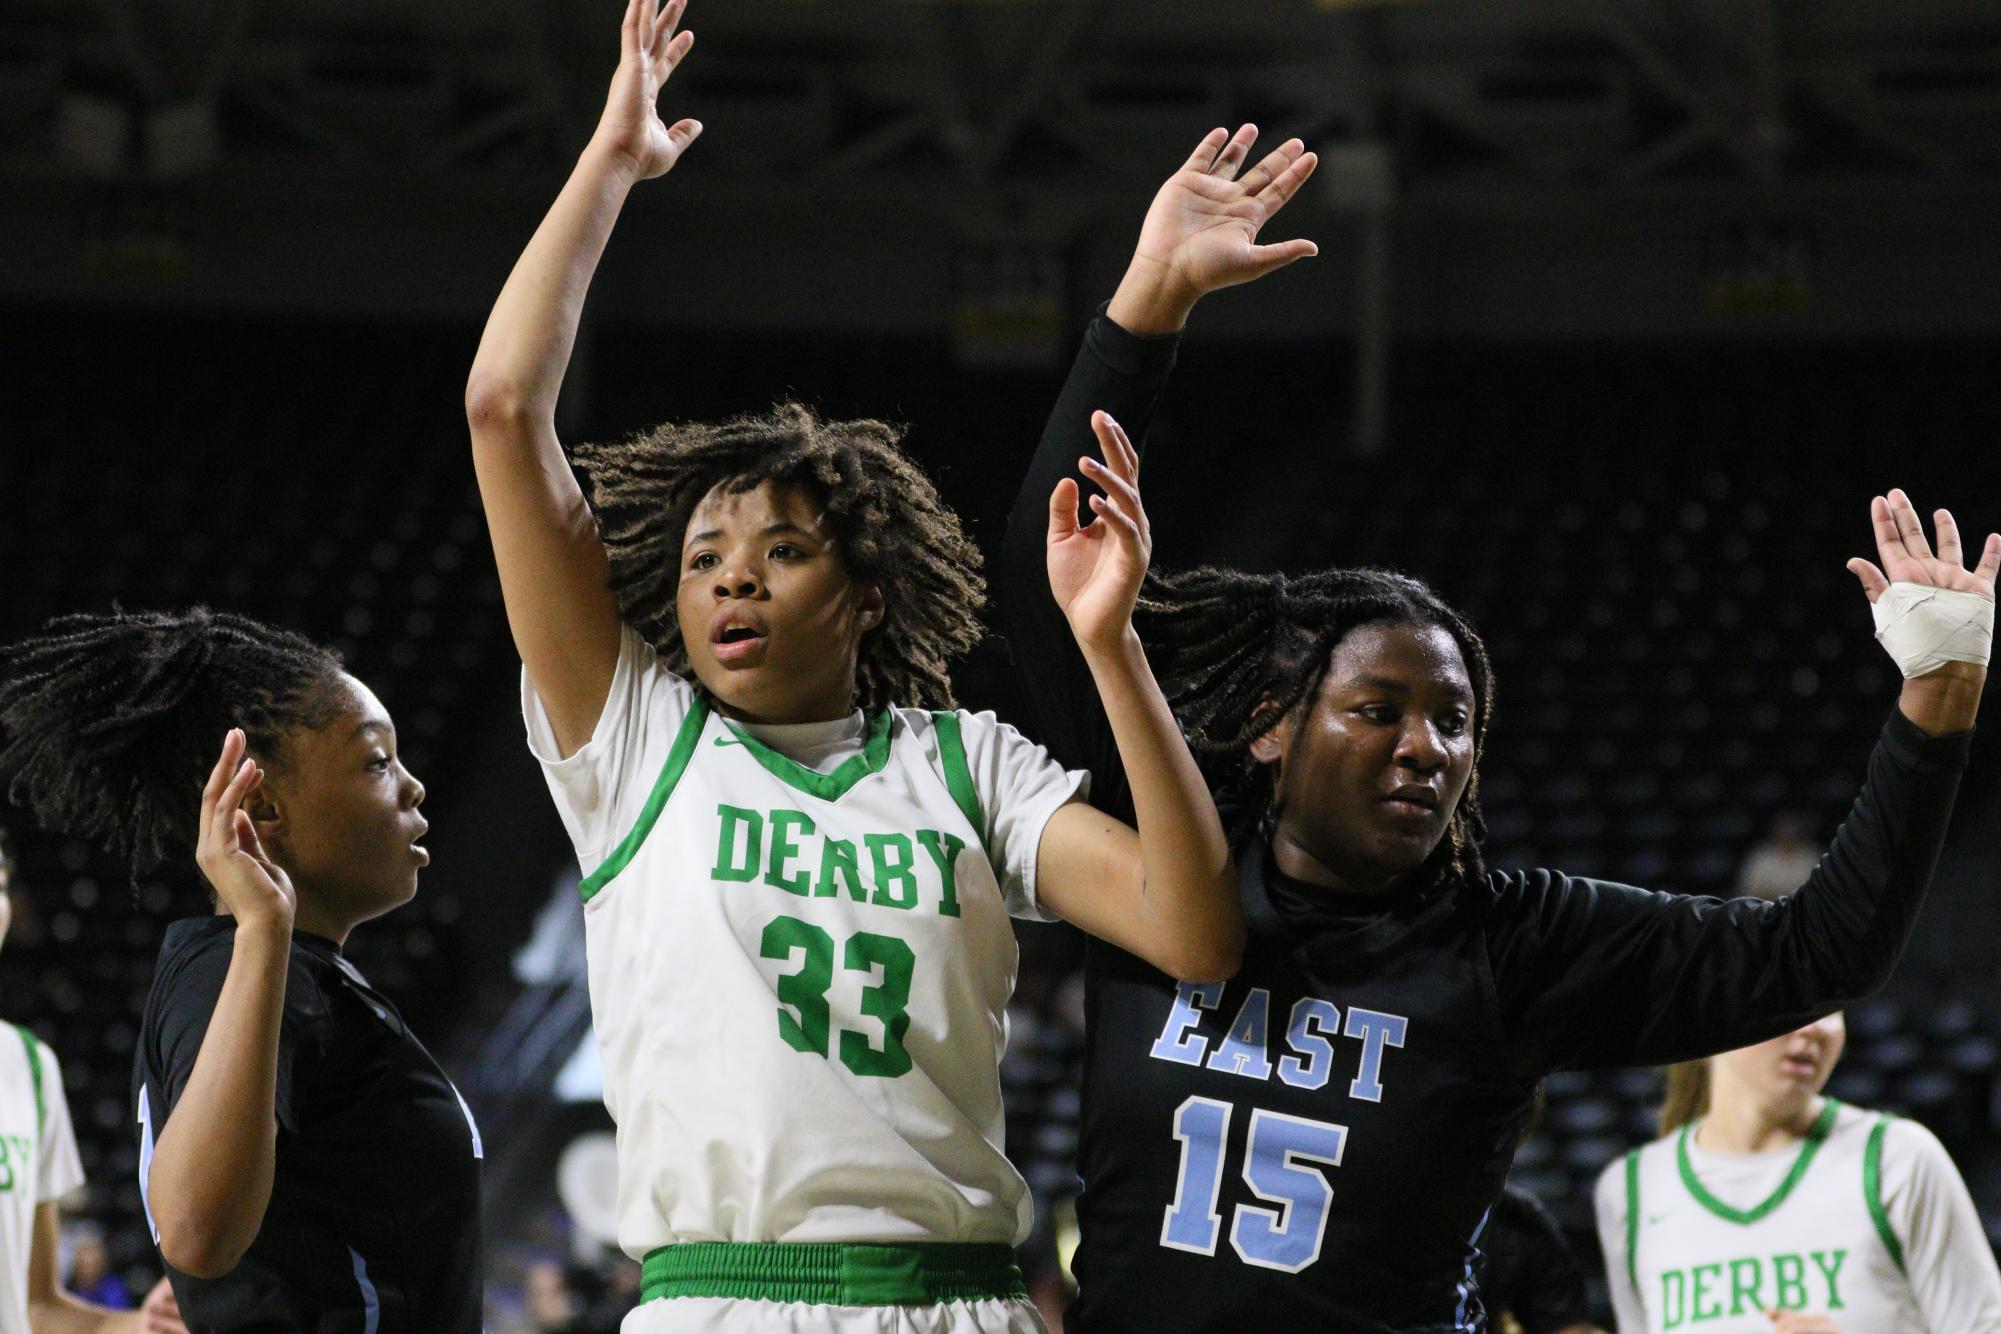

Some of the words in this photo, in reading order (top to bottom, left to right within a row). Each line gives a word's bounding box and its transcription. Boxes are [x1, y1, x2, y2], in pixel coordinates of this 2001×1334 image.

[711, 803, 966, 918] DERBY
[760, 915, 916, 1078] 33
[1150, 980, 1408, 1103] EAST
[1159, 1094, 1349, 1274] 15
[1661, 1248, 1847, 1330] DERBY
